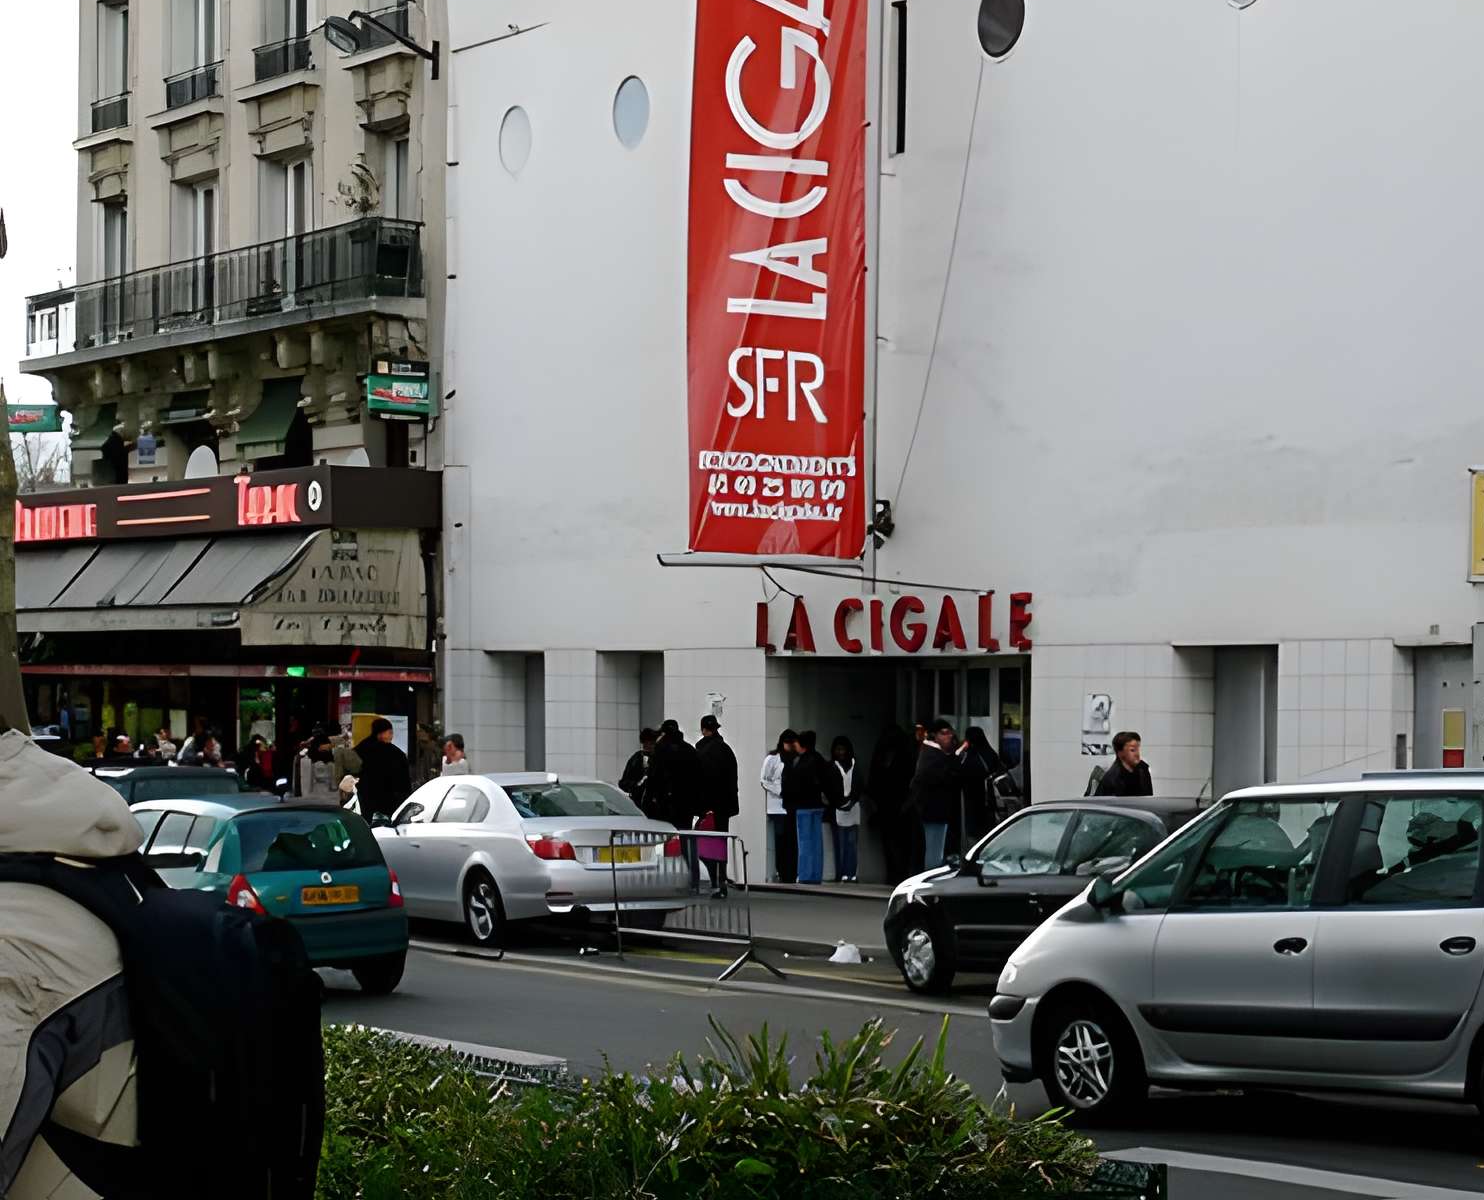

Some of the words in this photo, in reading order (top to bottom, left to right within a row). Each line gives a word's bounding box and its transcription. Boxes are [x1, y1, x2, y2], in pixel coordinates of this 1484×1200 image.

[726, 234, 829, 321] LA
[726, 346, 828, 424] SFR
[756, 596, 816, 655] LA
[833, 592, 1033, 653] CIGALE
